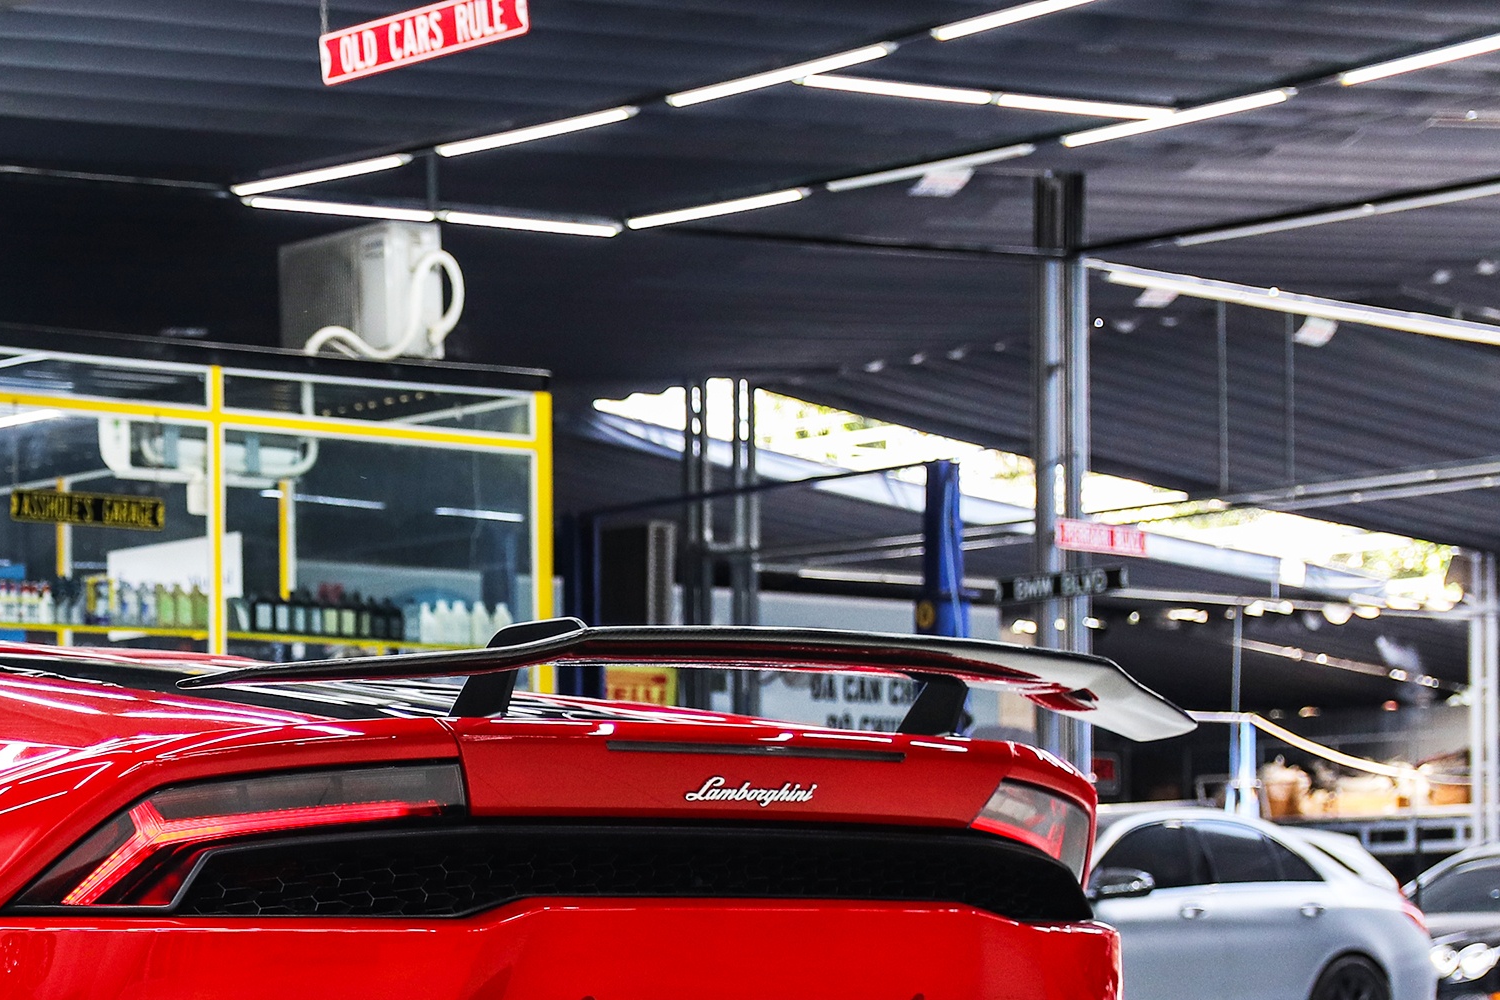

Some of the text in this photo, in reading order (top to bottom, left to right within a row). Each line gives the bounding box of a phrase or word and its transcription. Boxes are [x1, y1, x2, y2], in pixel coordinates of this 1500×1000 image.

[339, 0, 509, 74] OLD CARS RULE
[1013, 567, 1108, 601] BMW BLVD
[685, 776, 818, 807] Lamborghini
